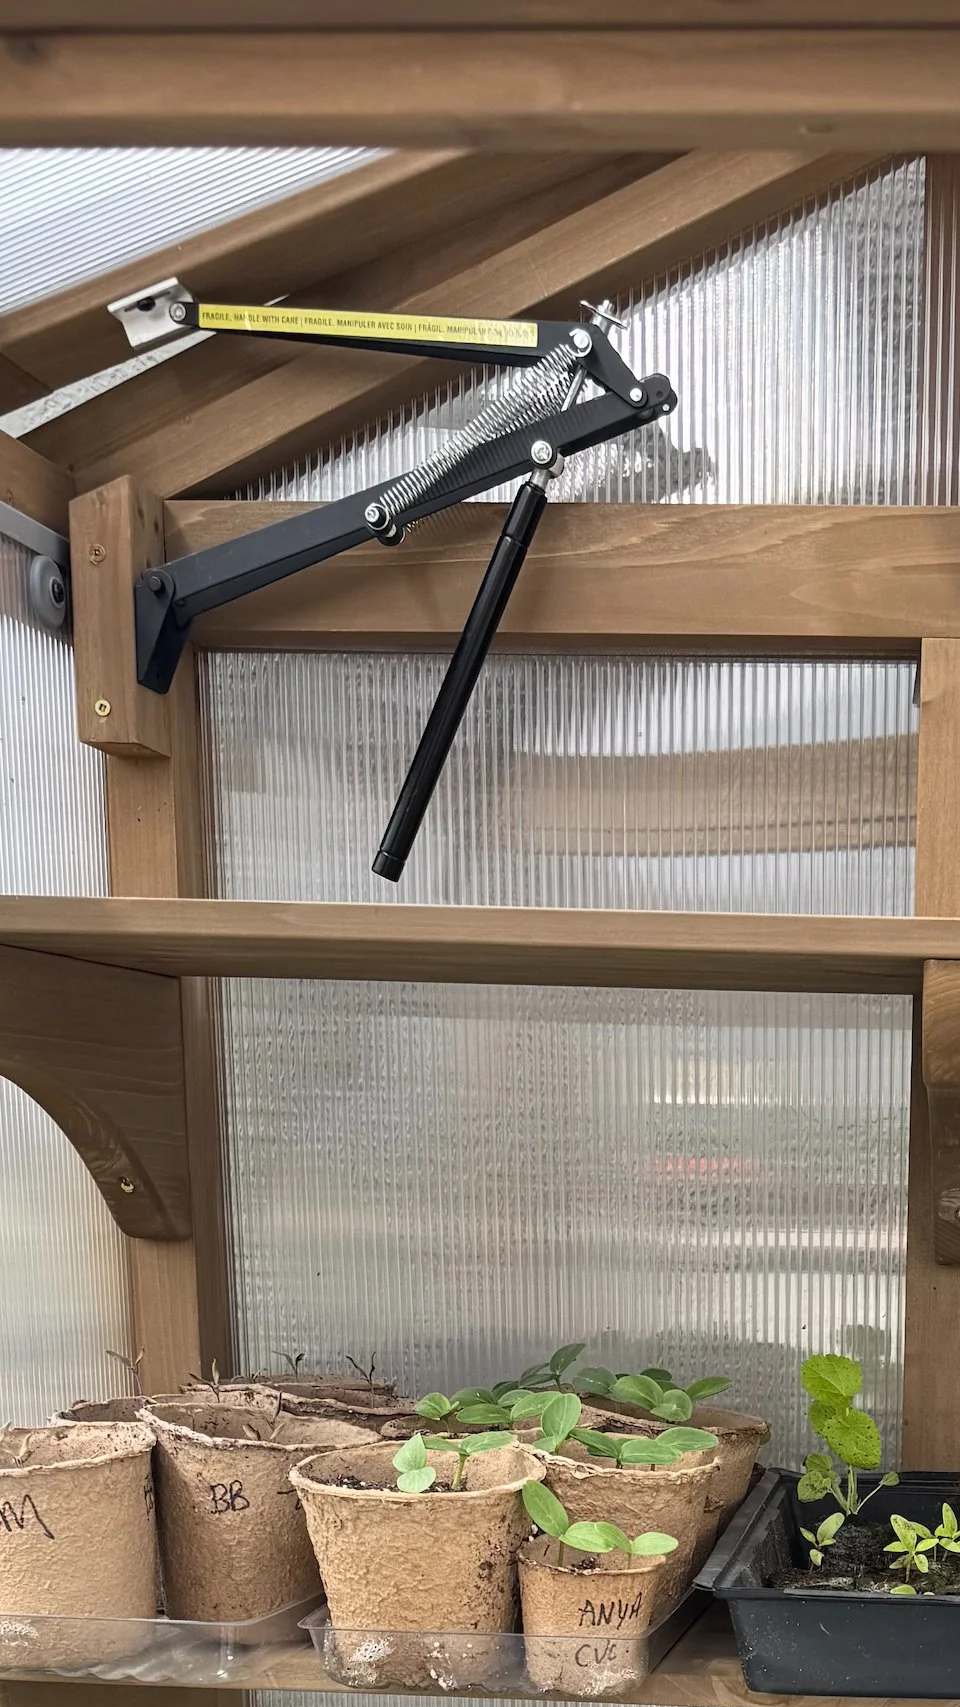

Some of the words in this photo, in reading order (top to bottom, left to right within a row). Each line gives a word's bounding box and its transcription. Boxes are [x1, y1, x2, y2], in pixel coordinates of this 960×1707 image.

[262, 315, 280, 324] WITH
[281, 315, 299, 325] CARE
[336, 318, 376, 329] MANIPULER
[377, 321, 395, 331] AVEC
[396, 321, 413, 332] SOIN
[446, 325, 487, 336] MANIPULAR
[211, 1480, 250, 1514] BB
[578, 1591, 643, 1631] ANYA
